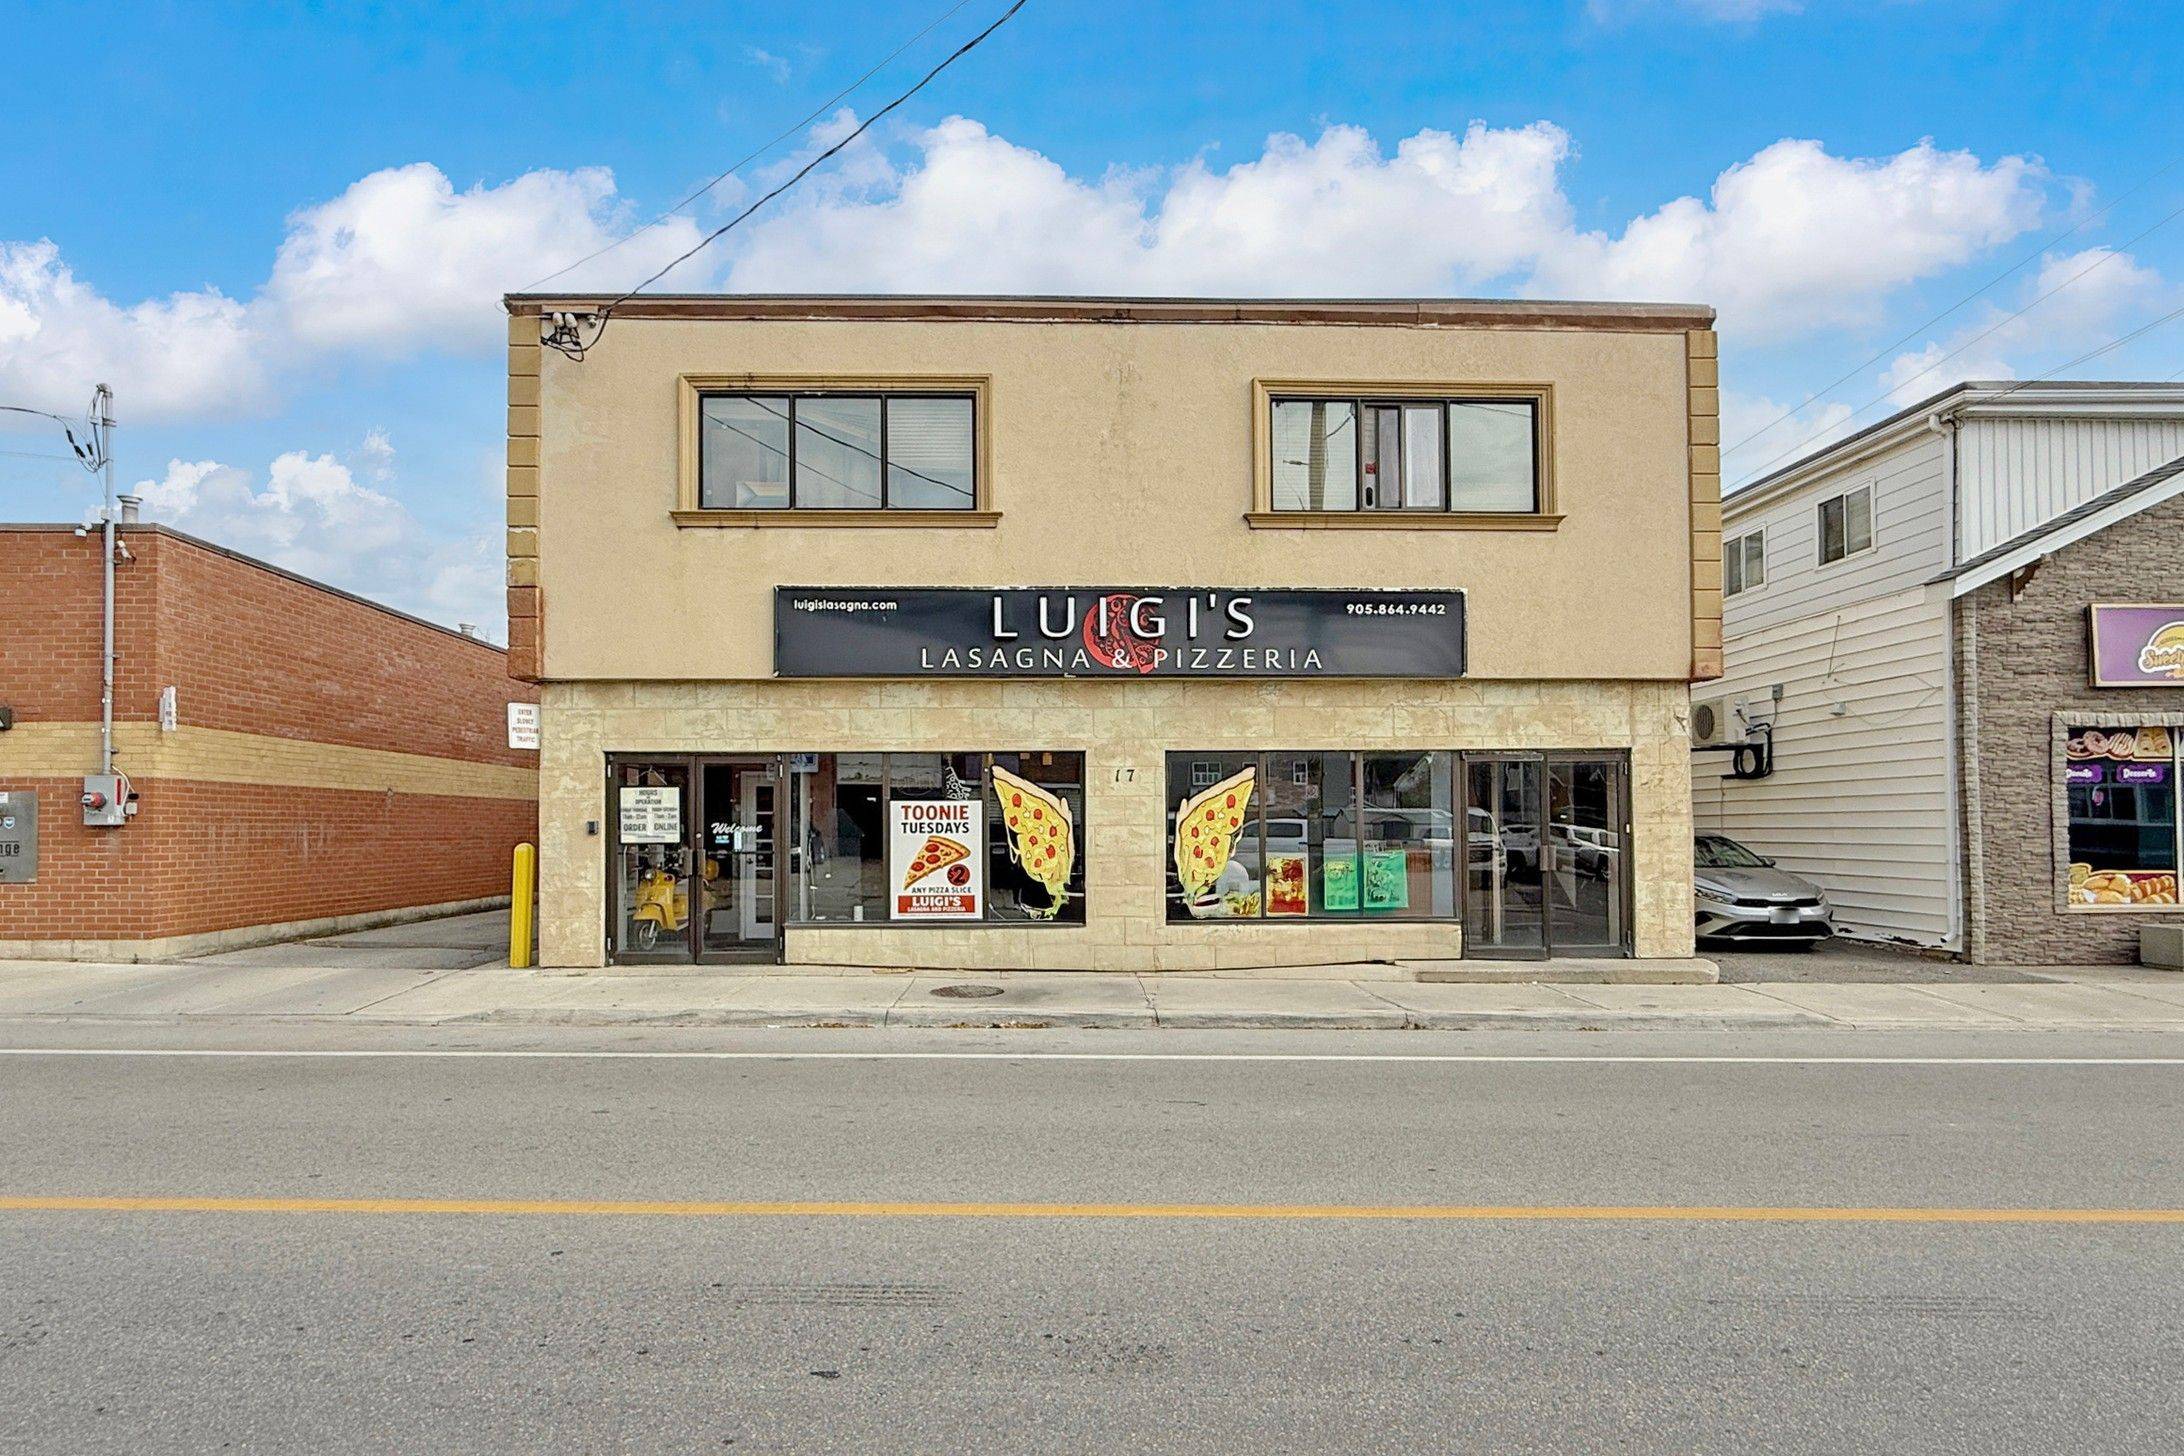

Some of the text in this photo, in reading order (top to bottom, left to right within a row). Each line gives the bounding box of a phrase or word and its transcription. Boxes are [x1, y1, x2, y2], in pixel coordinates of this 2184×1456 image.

[794, 599, 897, 612] luigislasagna.com
[1347, 604, 1446, 615] 905.864.9442
[993, 594, 1255, 638] LUIGI'S
[922, 648, 1323, 669] LASAGNA & PIZZERIA
[2142, 648, 2184, 669] Sweet
[1115, 769, 1135, 782] 17
[901, 805, 969, 820] TOONIE
[623, 823, 647, 831] ORDER
[654, 823, 677, 831] ONLINE
[711, 822, 763, 834] Welcome
[901, 822, 970, 834] TUESDAYS
[912, 896, 962, 907] LUIGI'S
